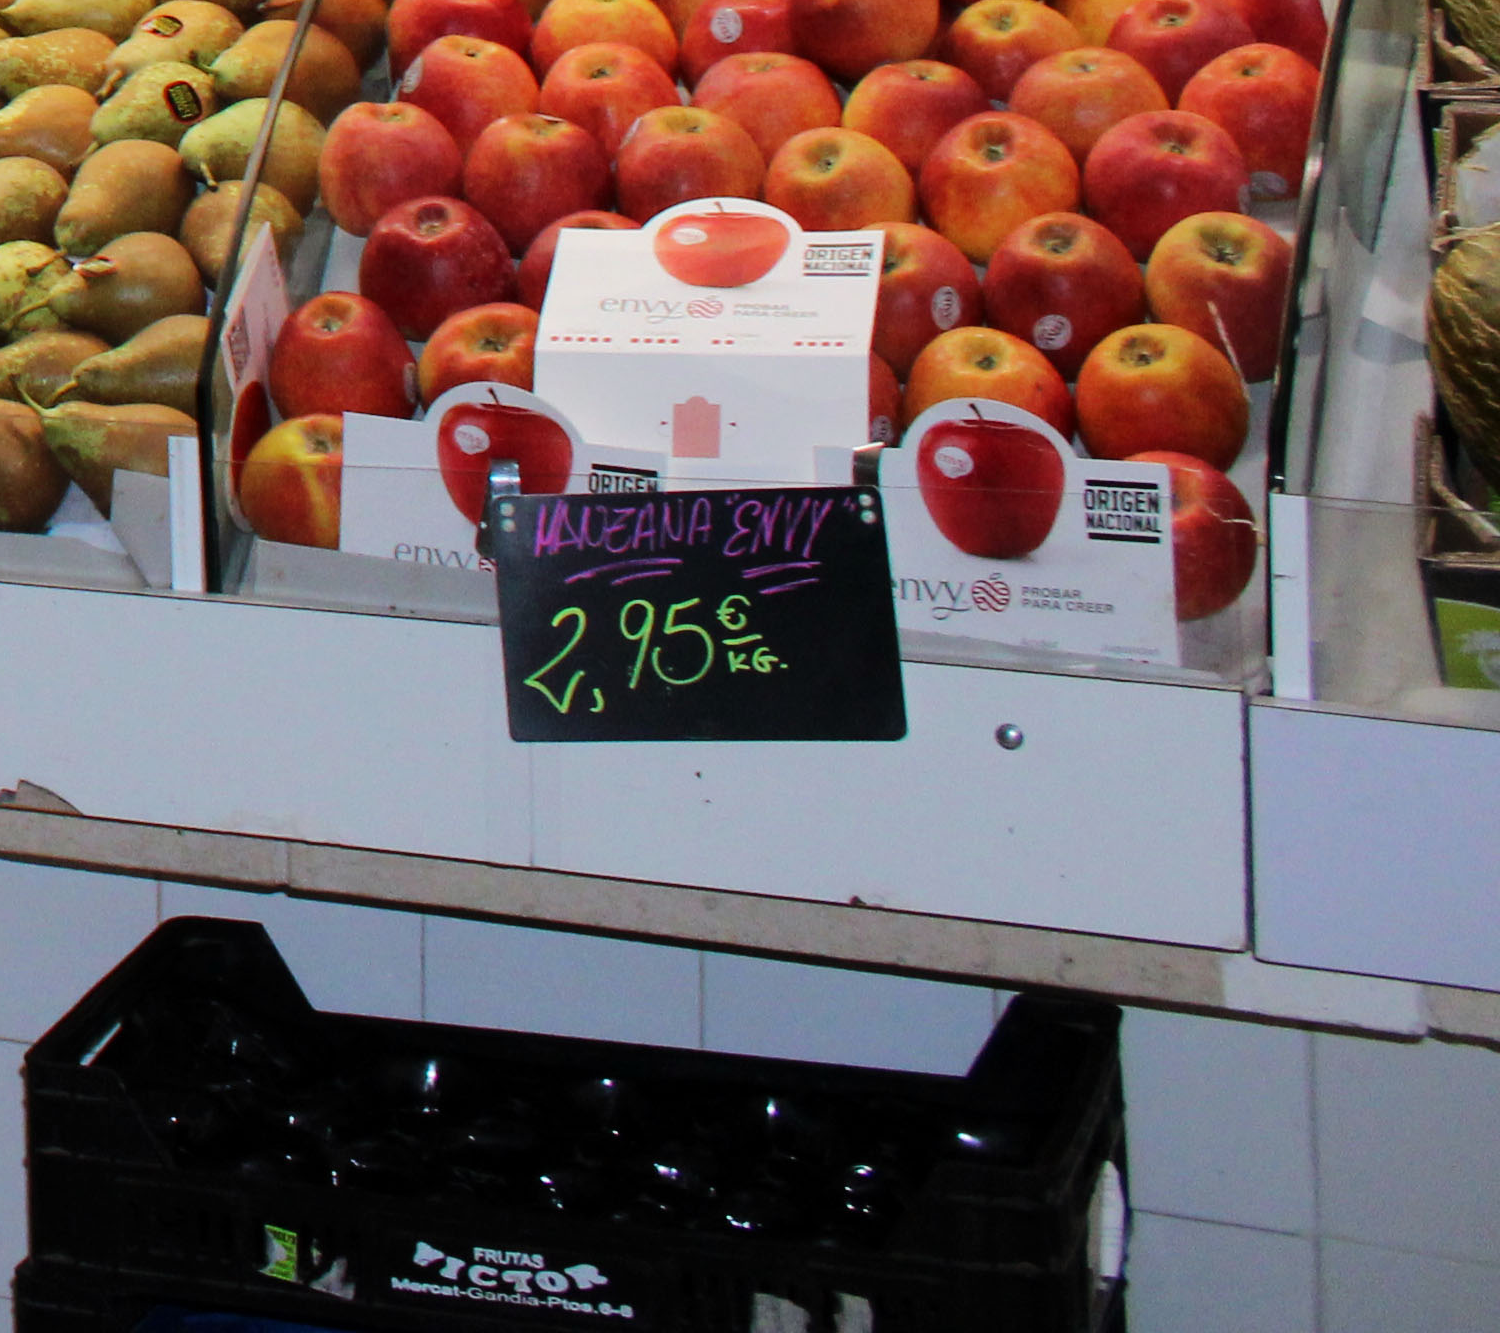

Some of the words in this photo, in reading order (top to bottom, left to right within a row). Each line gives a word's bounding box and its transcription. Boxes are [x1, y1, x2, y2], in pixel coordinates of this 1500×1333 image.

[803, 247, 875, 261] ORIGEN
[802, 261, 873, 272] NACIONAL
[599, 295, 684, 324] envy
[1083, 488, 1160, 514] ORIGEN
[533, 496, 714, 558] MANZANA
[1085, 512, 1163, 534] NACIONAL
[1020, 585, 1082, 599] PROBAR
[1021, 598, 1062, 612] PARA
[1064, 599, 1116, 615] CREER
[471, 1246, 546, 1270] FRUTAS
